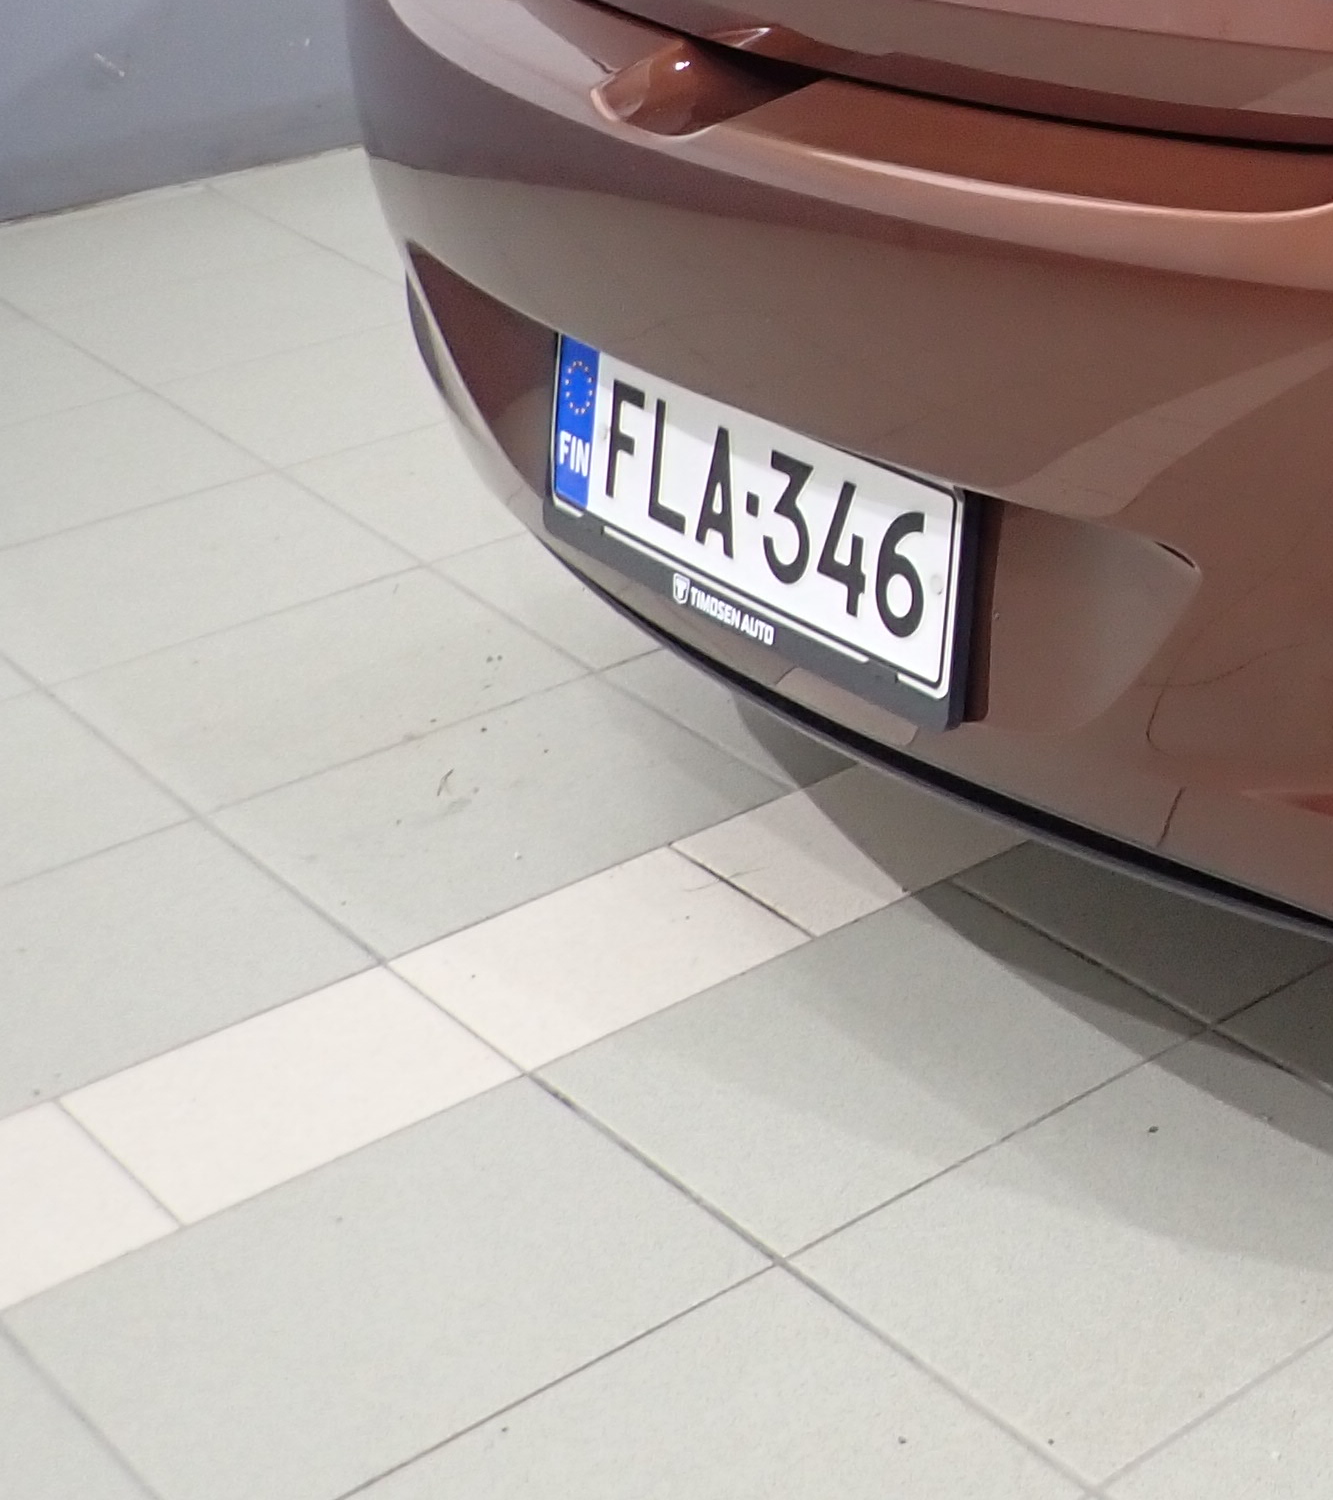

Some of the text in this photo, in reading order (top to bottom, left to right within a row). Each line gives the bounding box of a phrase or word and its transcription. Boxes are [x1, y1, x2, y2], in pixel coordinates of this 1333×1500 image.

[559, 430, 591, 477] FIN
[605, 379, 926, 639] FLA-346
[691, 586, 741, 629] TIMOSEN
[740, 613, 774, 646] AUTO
